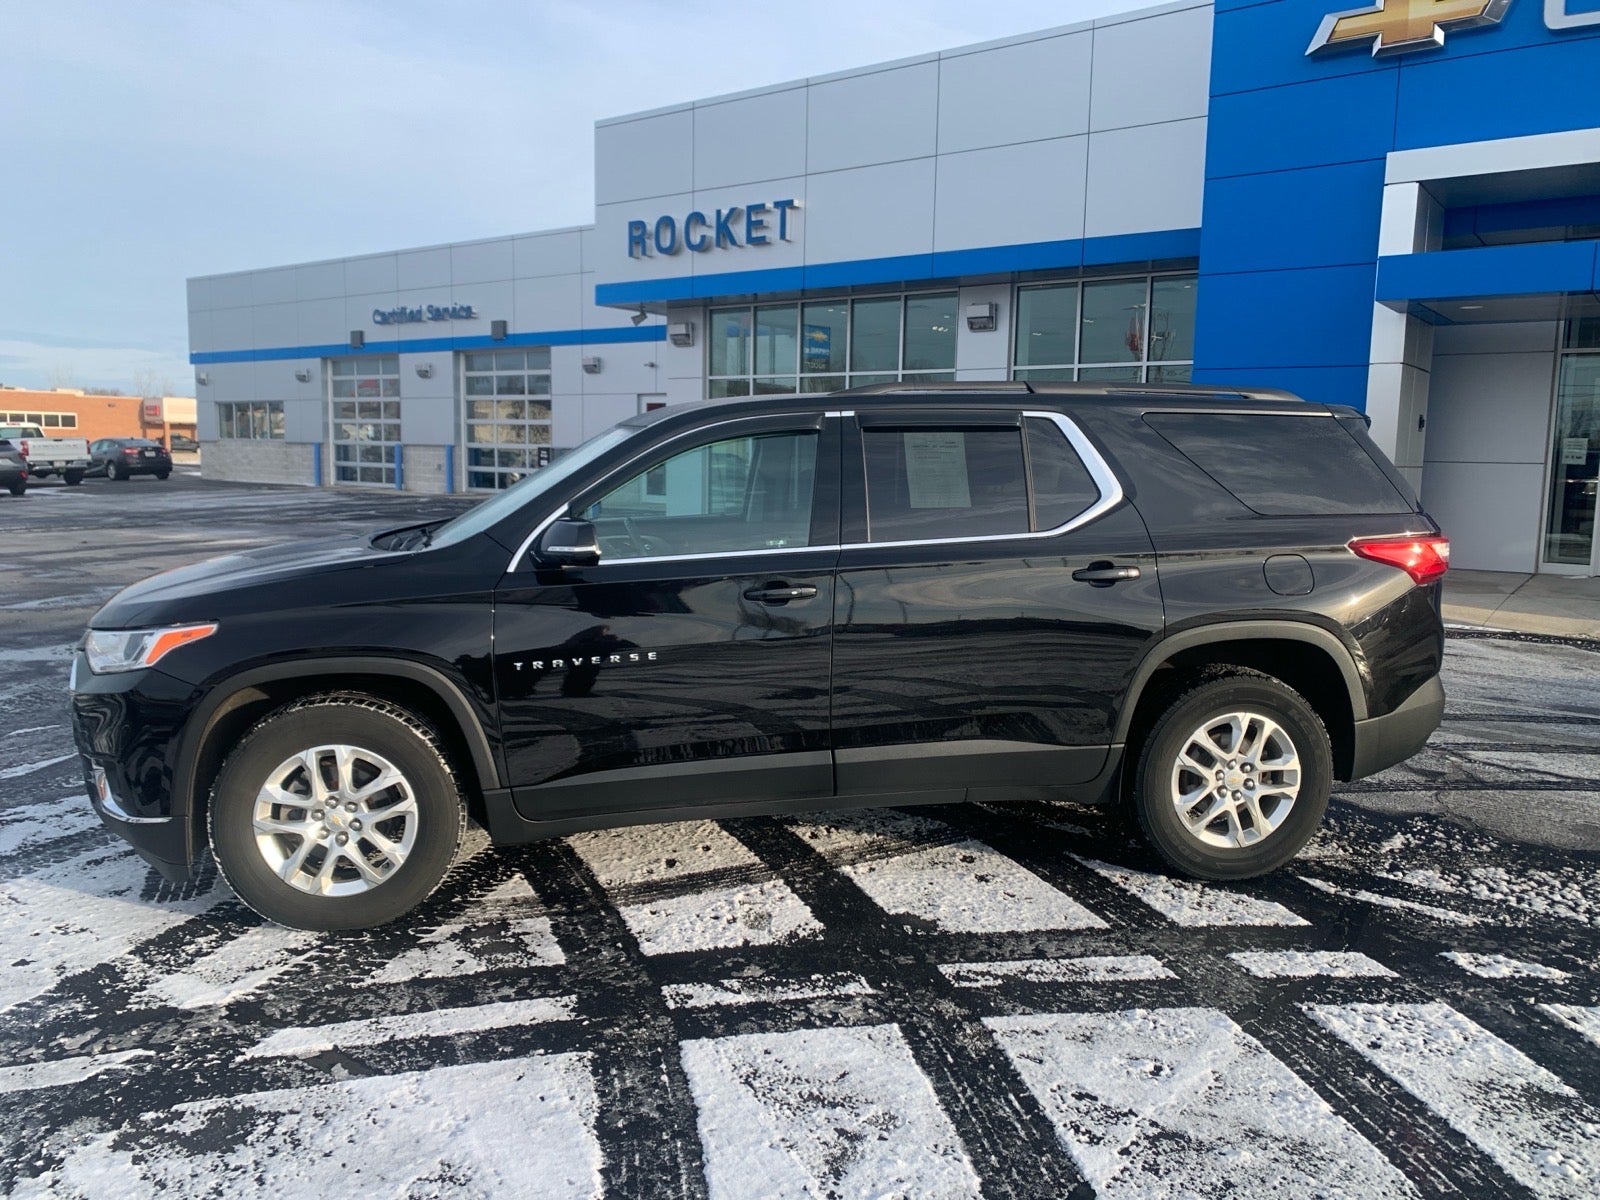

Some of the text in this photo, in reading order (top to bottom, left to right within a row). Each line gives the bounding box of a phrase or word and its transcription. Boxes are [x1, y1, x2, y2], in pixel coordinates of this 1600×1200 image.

[628, 199, 795, 258] ROCKET
[373, 302, 475, 324] Certified Service
[513, 652, 657, 671] TRAVERSE
